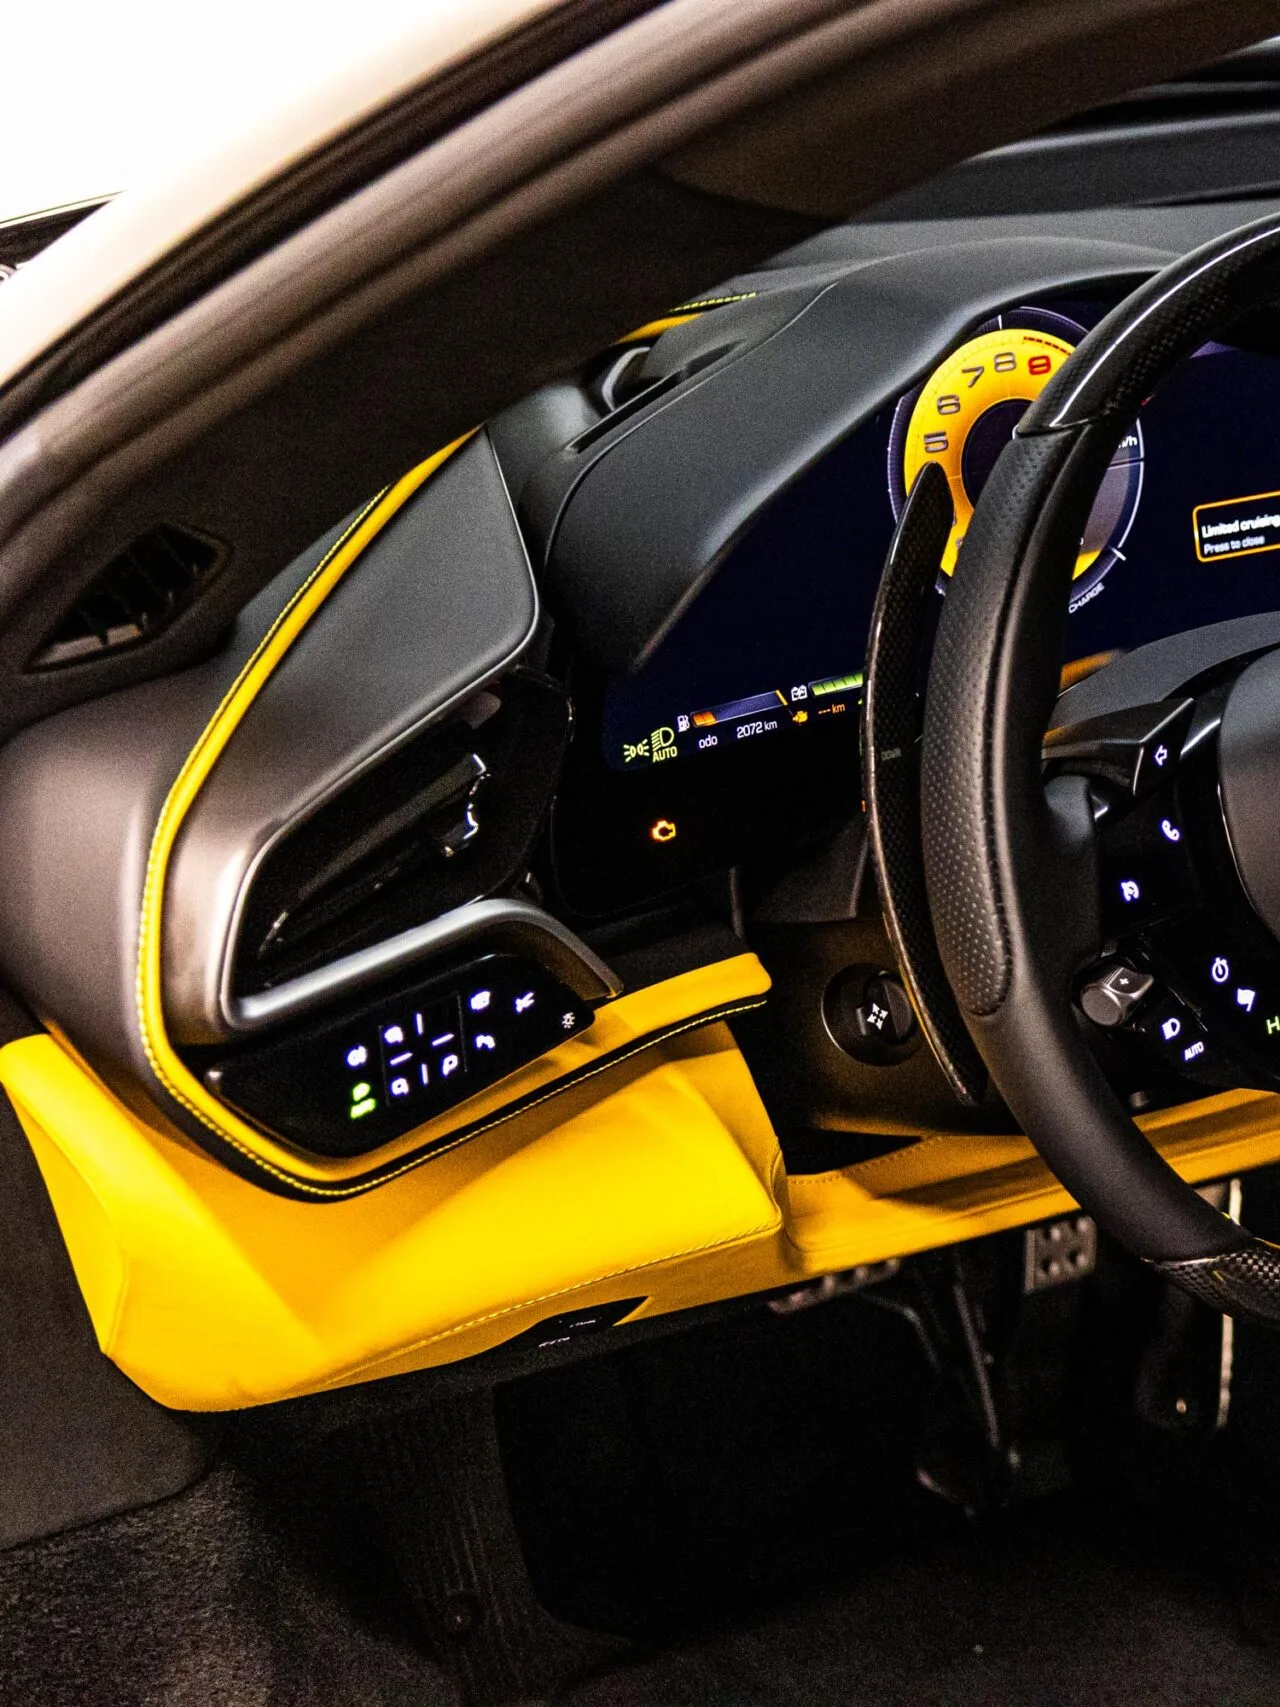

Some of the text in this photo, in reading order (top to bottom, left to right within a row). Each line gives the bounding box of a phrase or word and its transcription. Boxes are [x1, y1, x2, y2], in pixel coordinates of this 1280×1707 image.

[924, 431, 949, 453] 5
[937, 395, 961, 415] 6
[962, 366, 985, 388] 7
[994, 352, 1017, 373] 8
[1201, 519, 1240, 538] Limited
[1240, 514, 1280, 531] cruising
[1203, 535, 1265, 555] Press to close
[1068, 581, 1105, 614] CHARGE
[831, 703, 846, 714] km
[698, 720, 778, 749] odo 2072 km
[652, 745, 678, 763] AUTO
[1266, 1015, 1280, 1035] H
[1184, 1041, 1204, 1061] AUTO
